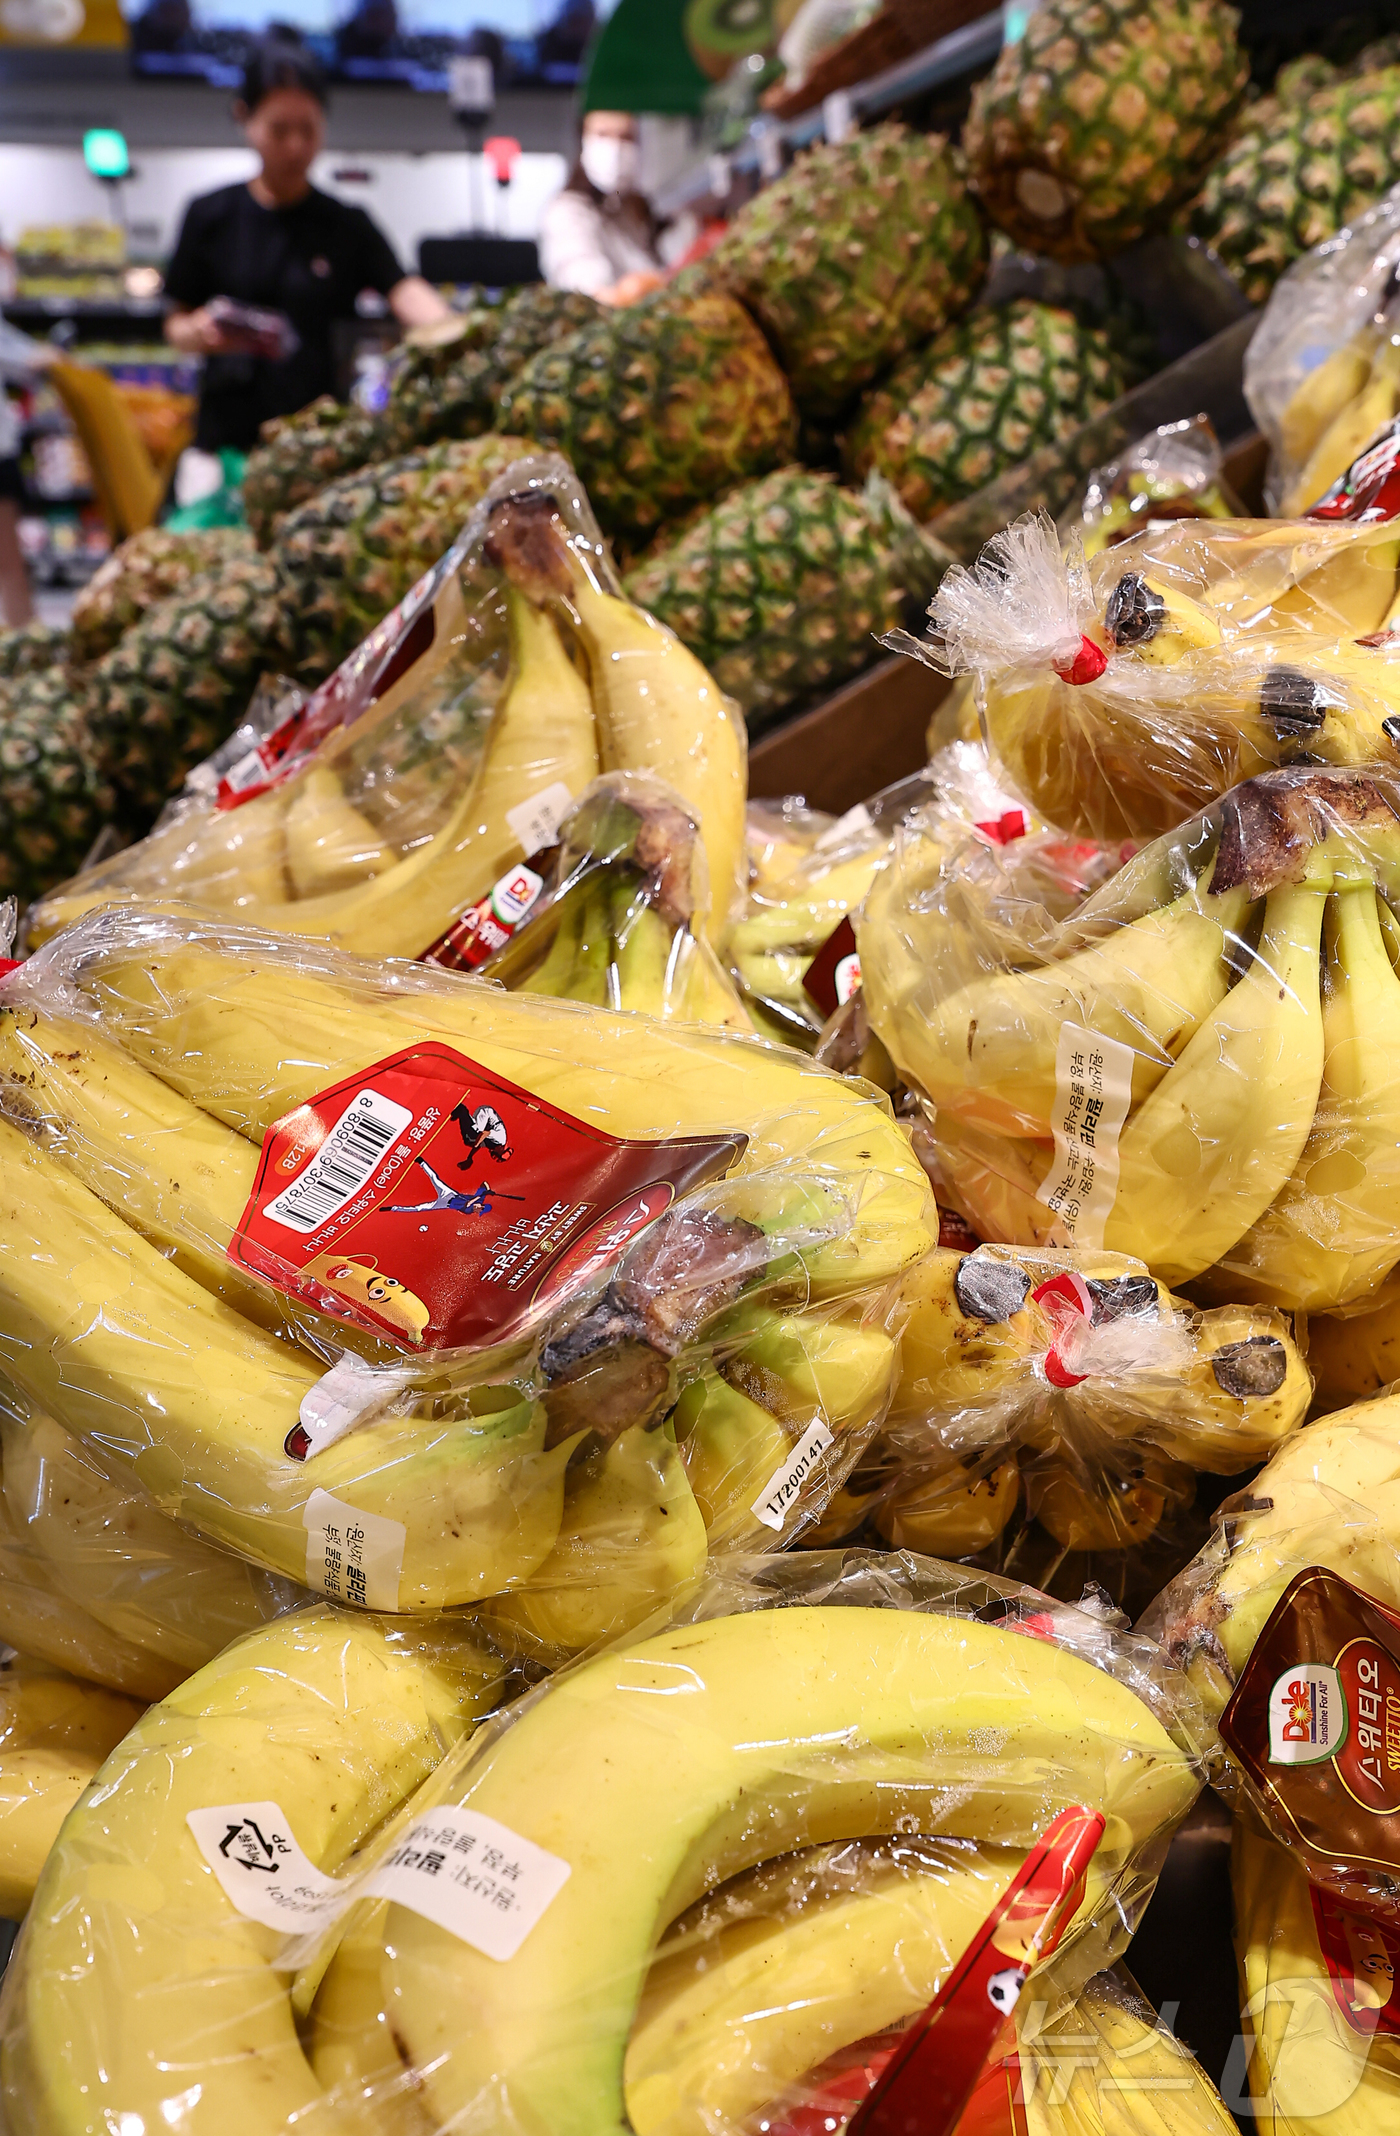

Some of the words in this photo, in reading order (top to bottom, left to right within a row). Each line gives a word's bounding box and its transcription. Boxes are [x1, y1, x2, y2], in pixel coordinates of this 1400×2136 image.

[1070, 1051, 1084, 1078] 부정,
[359, 1097, 373, 1108] 8
[1063, 1082, 1085, 1136] 불량식품
[319, 1112, 361, 1166] 809069
[408, 1106, 441, 1143] 상품명:
[1080, 1097, 1104, 1149] 필리핀
[373, 1144, 411, 1189] 돌(Dole)
[1066, 1136, 1080, 1170] 신고는
[275, 1168, 323, 1211] 307875
[335, 1190, 376, 1225] 스위티오
[1047, 1174, 1076, 1214] 국번없
[486, 1218, 532, 1255] 바나나
[522, 1201, 570, 1240] 고산지
[551, 1229, 563, 1242] BY
[562, 1205, 588, 1230] SWEET
[303, 1225, 339, 1253] 바나나
[480, 1240, 529, 1283] 고당도
[507, 1252, 542, 1286] NATURE
[766, 1439, 823, 1515] 17200141
[324, 1546, 342, 1592] 불량식품
[346, 1564, 368, 1606] 필리핀
[1281, 1680, 1313, 1742] Dole
[1319, 1696, 1329, 1709] For
[1319, 1710, 1329, 1745] Sunshine
[1357, 1658, 1385, 1792] 스위티오
[272, 1834, 292, 1854] PP
